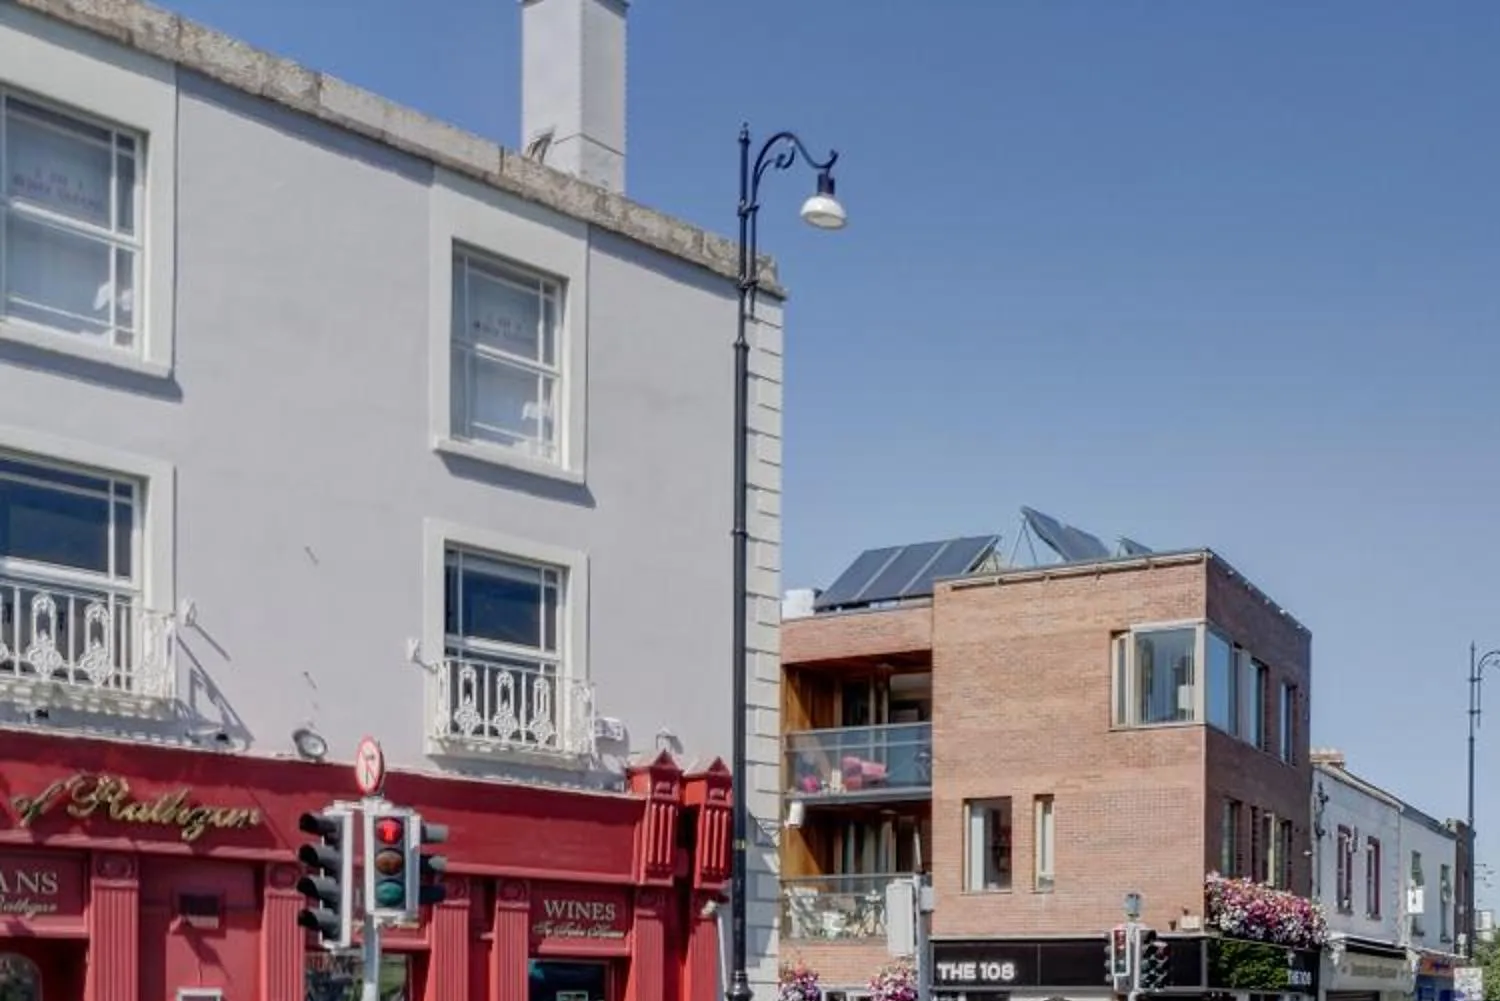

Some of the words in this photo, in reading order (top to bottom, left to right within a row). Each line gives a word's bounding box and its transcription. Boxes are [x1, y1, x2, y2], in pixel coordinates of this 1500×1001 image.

[543, 899, 616, 921] WINES
[937, 962, 977, 980] THE
[980, 962, 1015, 980] 108
